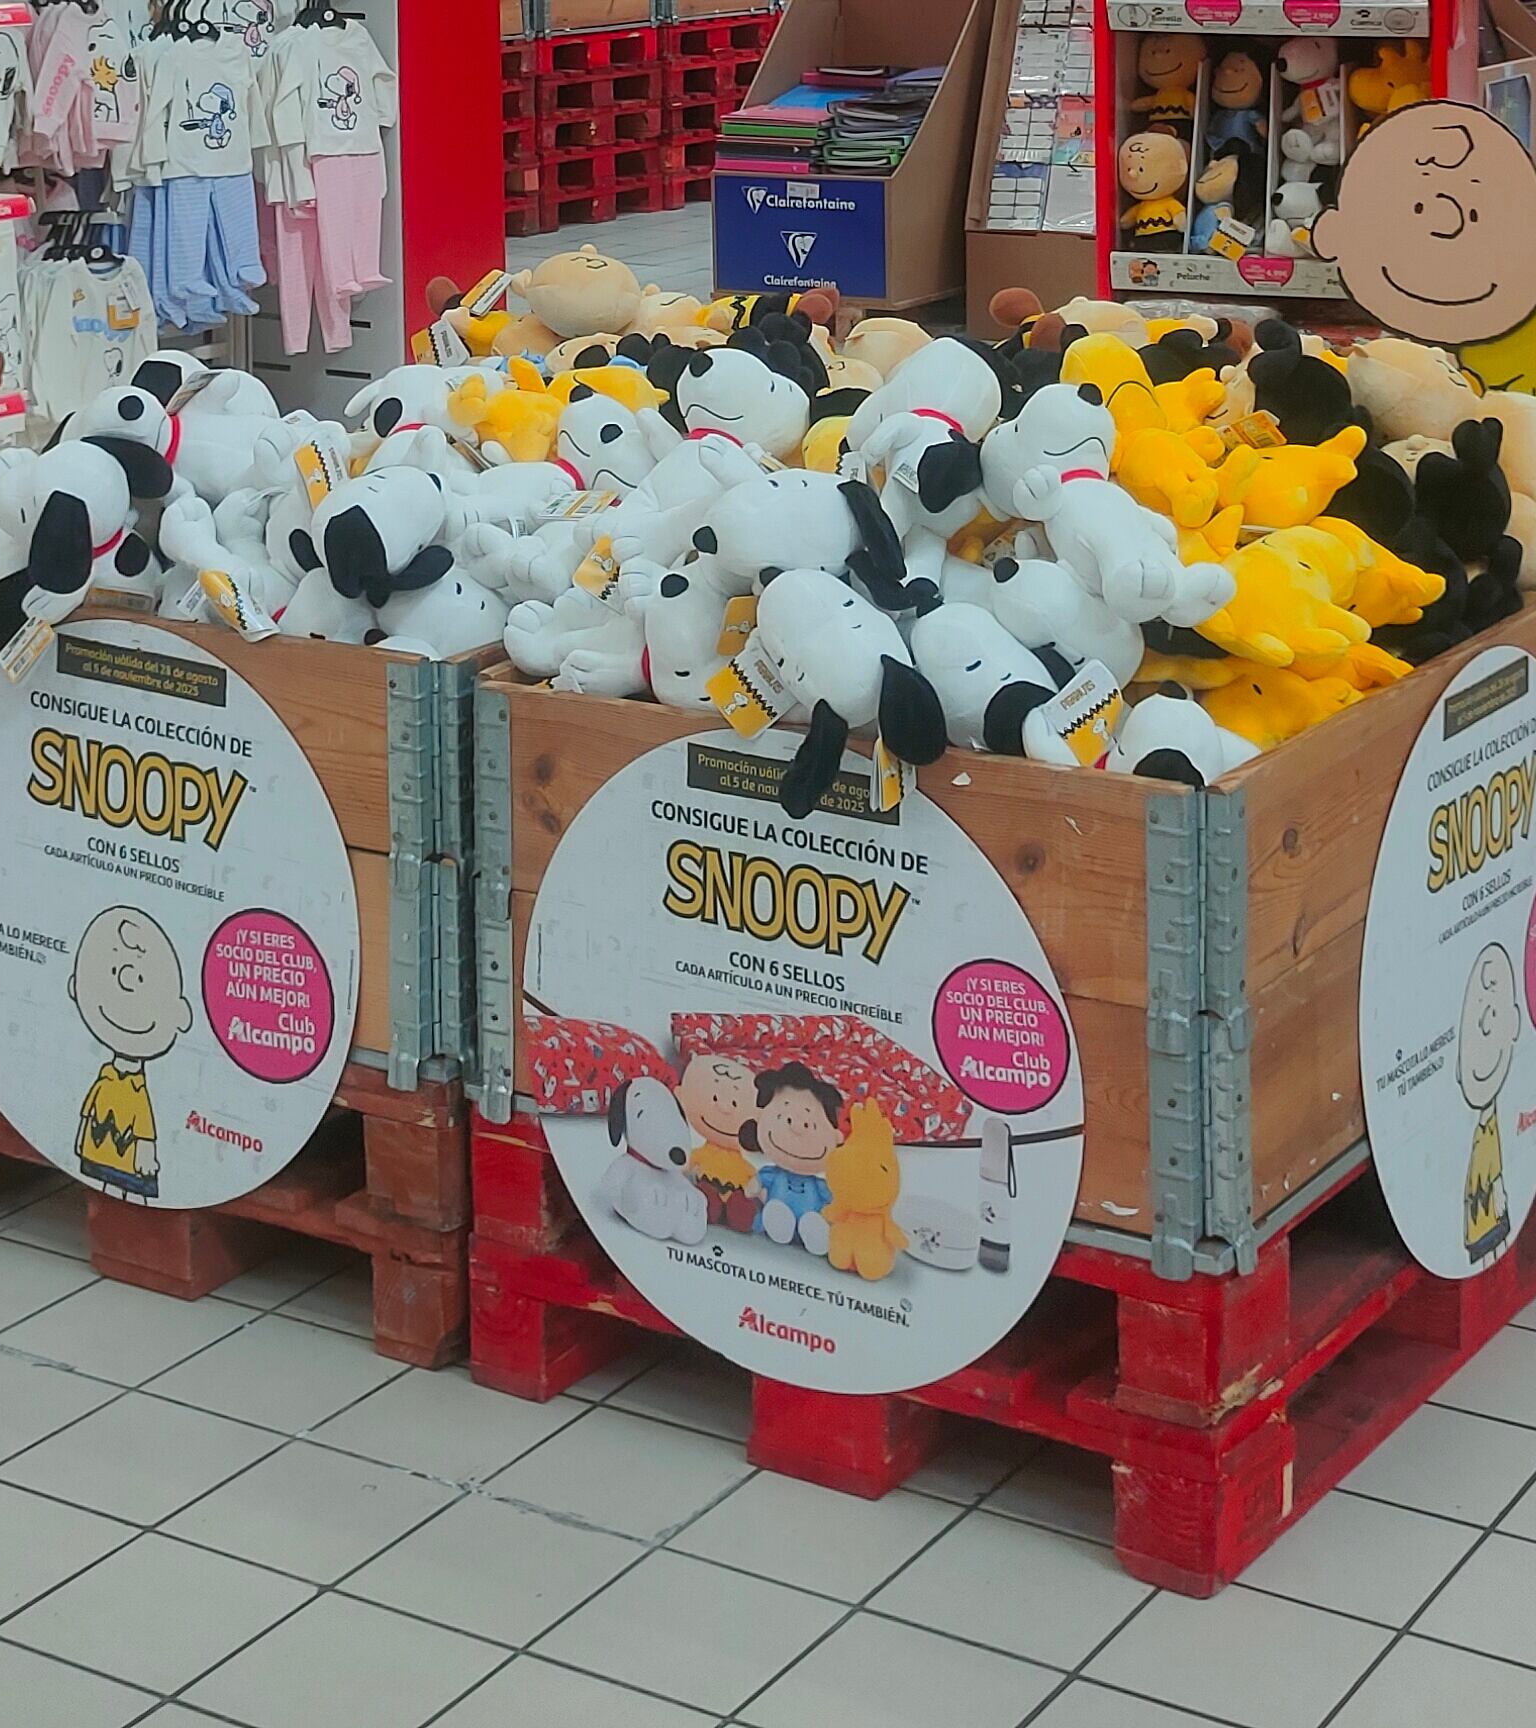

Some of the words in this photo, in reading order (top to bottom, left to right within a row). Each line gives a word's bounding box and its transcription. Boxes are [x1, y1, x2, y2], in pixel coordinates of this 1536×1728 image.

[766, 194, 856, 211] Clairefontaine
[30, 690, 109, 724] CONSIGUE
[113, 709, 131, 730] LA
[135, 715, 226, 752] COLECCIÓN
[231, 737, 253, 757] DE
[27, 727, 249, 852] SNOOPY
[698, 753, 757, 778] Promoción
[833, 780, 847, 792] de
[732, 776, 739, 788] 5
[836, 798, 865, 813] 2025
[651, 800, 749, 837] CONSIGUE
[754, 819, 777, 844] LA
[781, 827, 895, 869] COLECCIÓN
[901, 851, 928, 875] DE
[87, 837, 115, 857] CON
[130, 848, 181, 874] SELLOS
[663, 839, 911, 966] SNOOPY
[215, 943, 254, 963] SOCIO
[255, 949, 280, 967] DEL
[282, 952, 317, 973] CLUB,
[229, 960, 251, 979] UN
[253, 965, 305, 987] PRECIO
[729, 951, 765, 973] CON
[769, 960, 779, 977] 6
[783, 963, 845, 992] SELLOS
[226, 977, 257, 1001] AÚN
[259, 986, 310, 1009] MEJOR!
[675, 960, 706, 978] CADA
[707, 967, 763, 992] ARTÍCULO
[765, 982, 773, 993] A
[795, 989, 837, 1009] PRECIO
[839, 998, 902, 1024] INCREÍBLE
[946, 991, 984, 1005] SOCIO
[987, 995, 1012, 1009] DEL
[980, 978, 991, 992] SI
[994, 980, 1026, 995] ERES
[278, 1012, 315, 1036] Club
[960, 1006, 982, 1022] UN
[986, 1010, 1038, 1027] PRECIO
[228, 1015, 316, 1055] Alcampo
[960, 1055, 1051, 1088] Alcampo
[1013, 1052, 1050, 1070] Club
[185, 1110, 263, 1153] Alcampo
[666, 1247, 683, 1262] TU
[686, 1252, 747, 1280] MASCOTA
[749, 1269, 765, 1284] LO
[768, 1275, 824, 1302] MERECE.
[827, 1290, 844, 1307] TÚ
[846, 1297, 910, 1327] TAMBIÉN.
[738, 1306, 837, 1354] Alcampo
